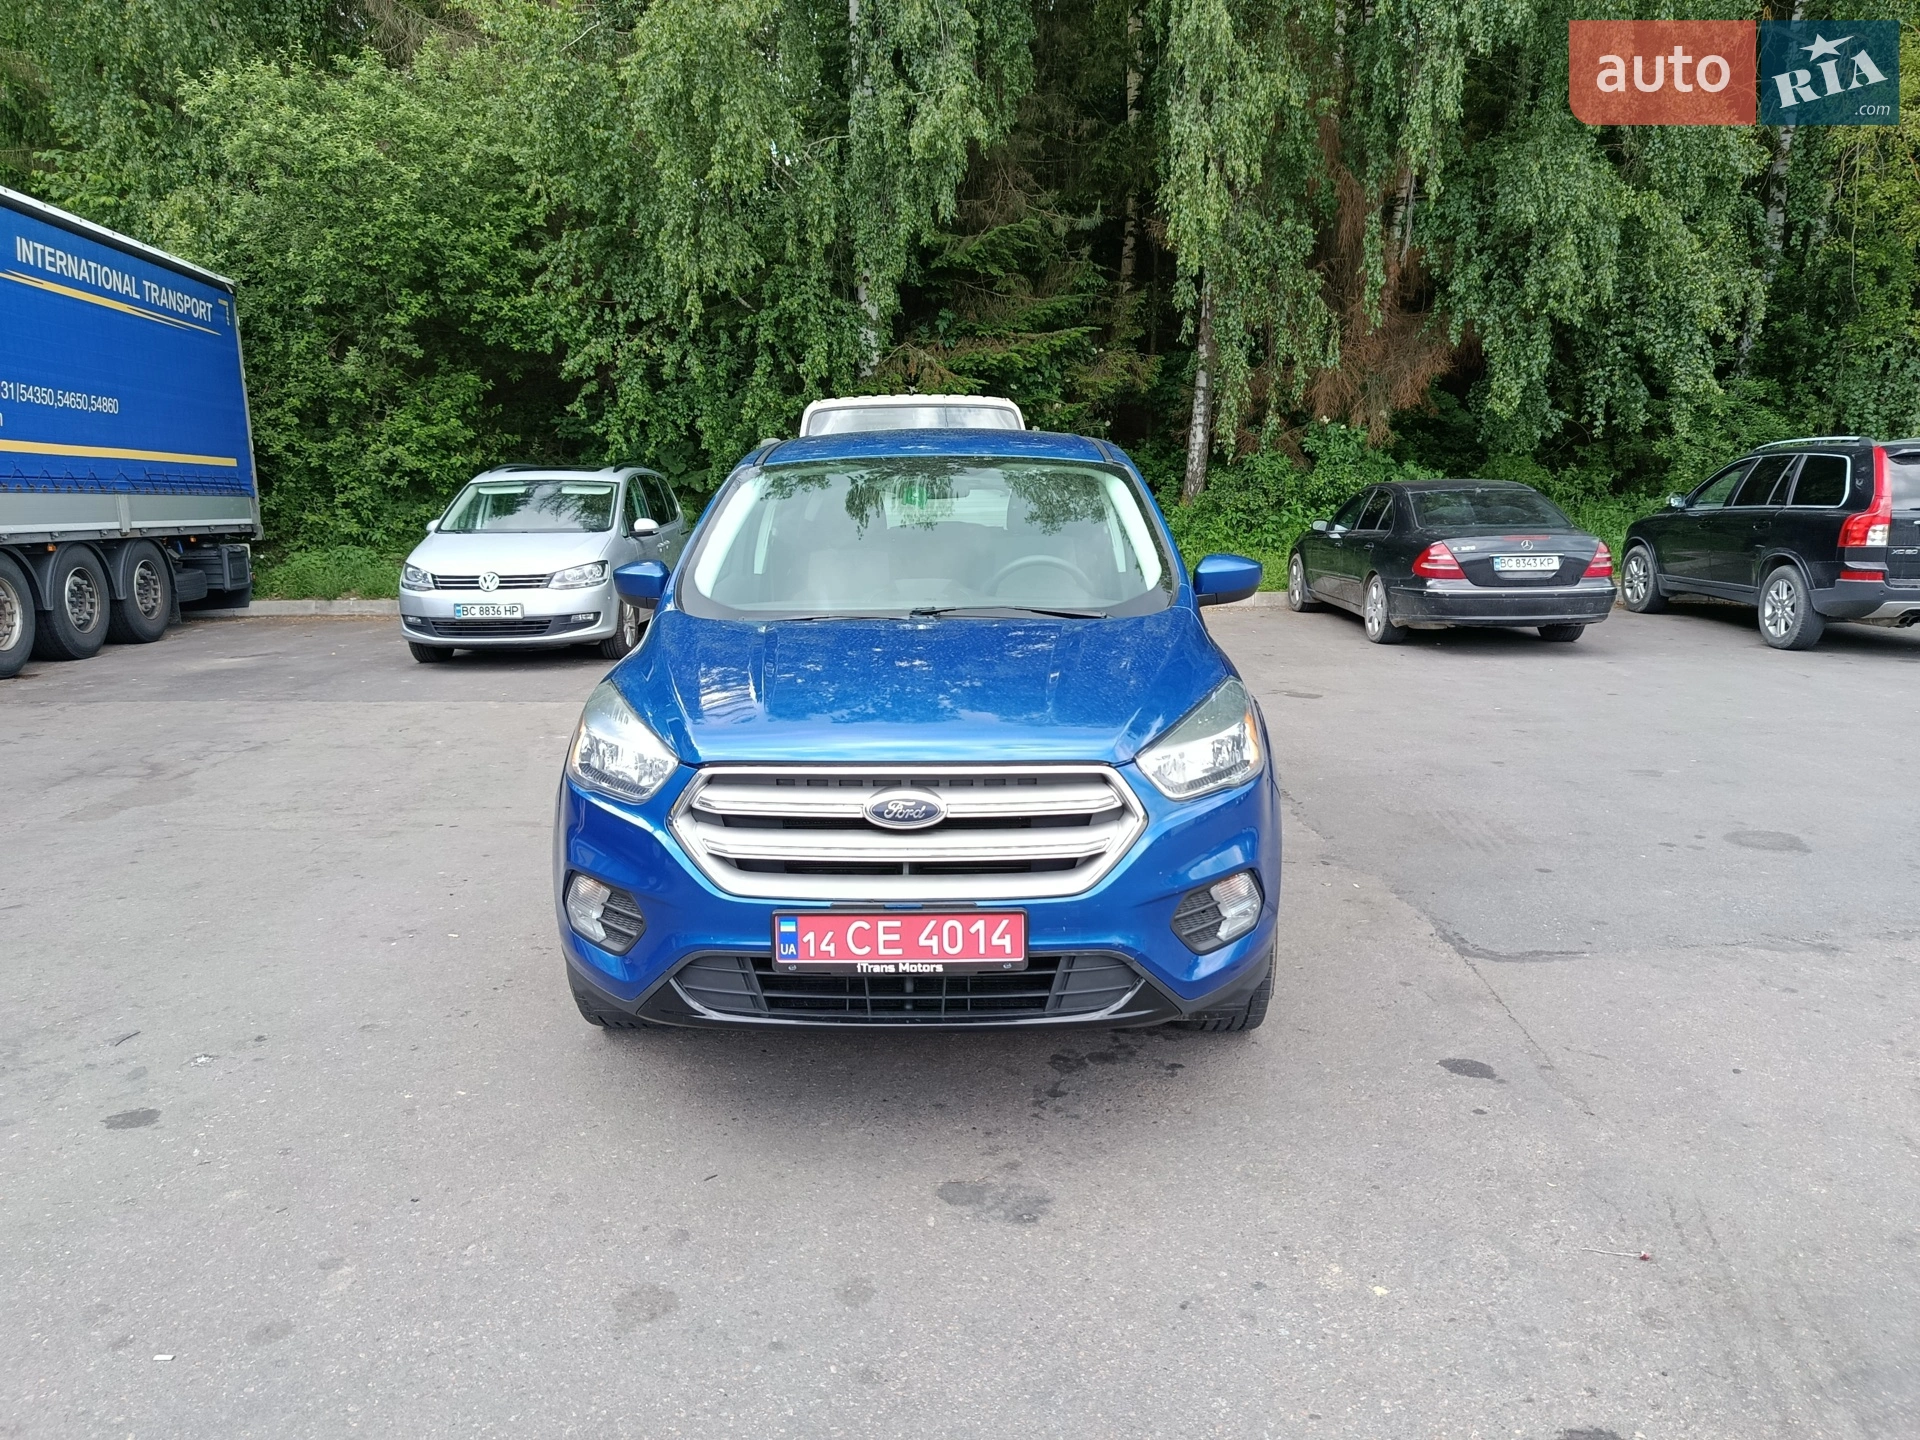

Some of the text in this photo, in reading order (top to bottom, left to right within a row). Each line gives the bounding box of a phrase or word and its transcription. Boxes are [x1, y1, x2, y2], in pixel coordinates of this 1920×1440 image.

[16, 235, 213, 322] INTERNATIONAL TRANSPORT
[1500, 557, 1554, 568] BC 8343 KP
[461, 606, 519, 616] BC 8836 HP
[884, 800, 927, 819] Ford
[780, 919, 1013, 957] UA 14 CE 4014
[899, 962, 944, 973] Motors
